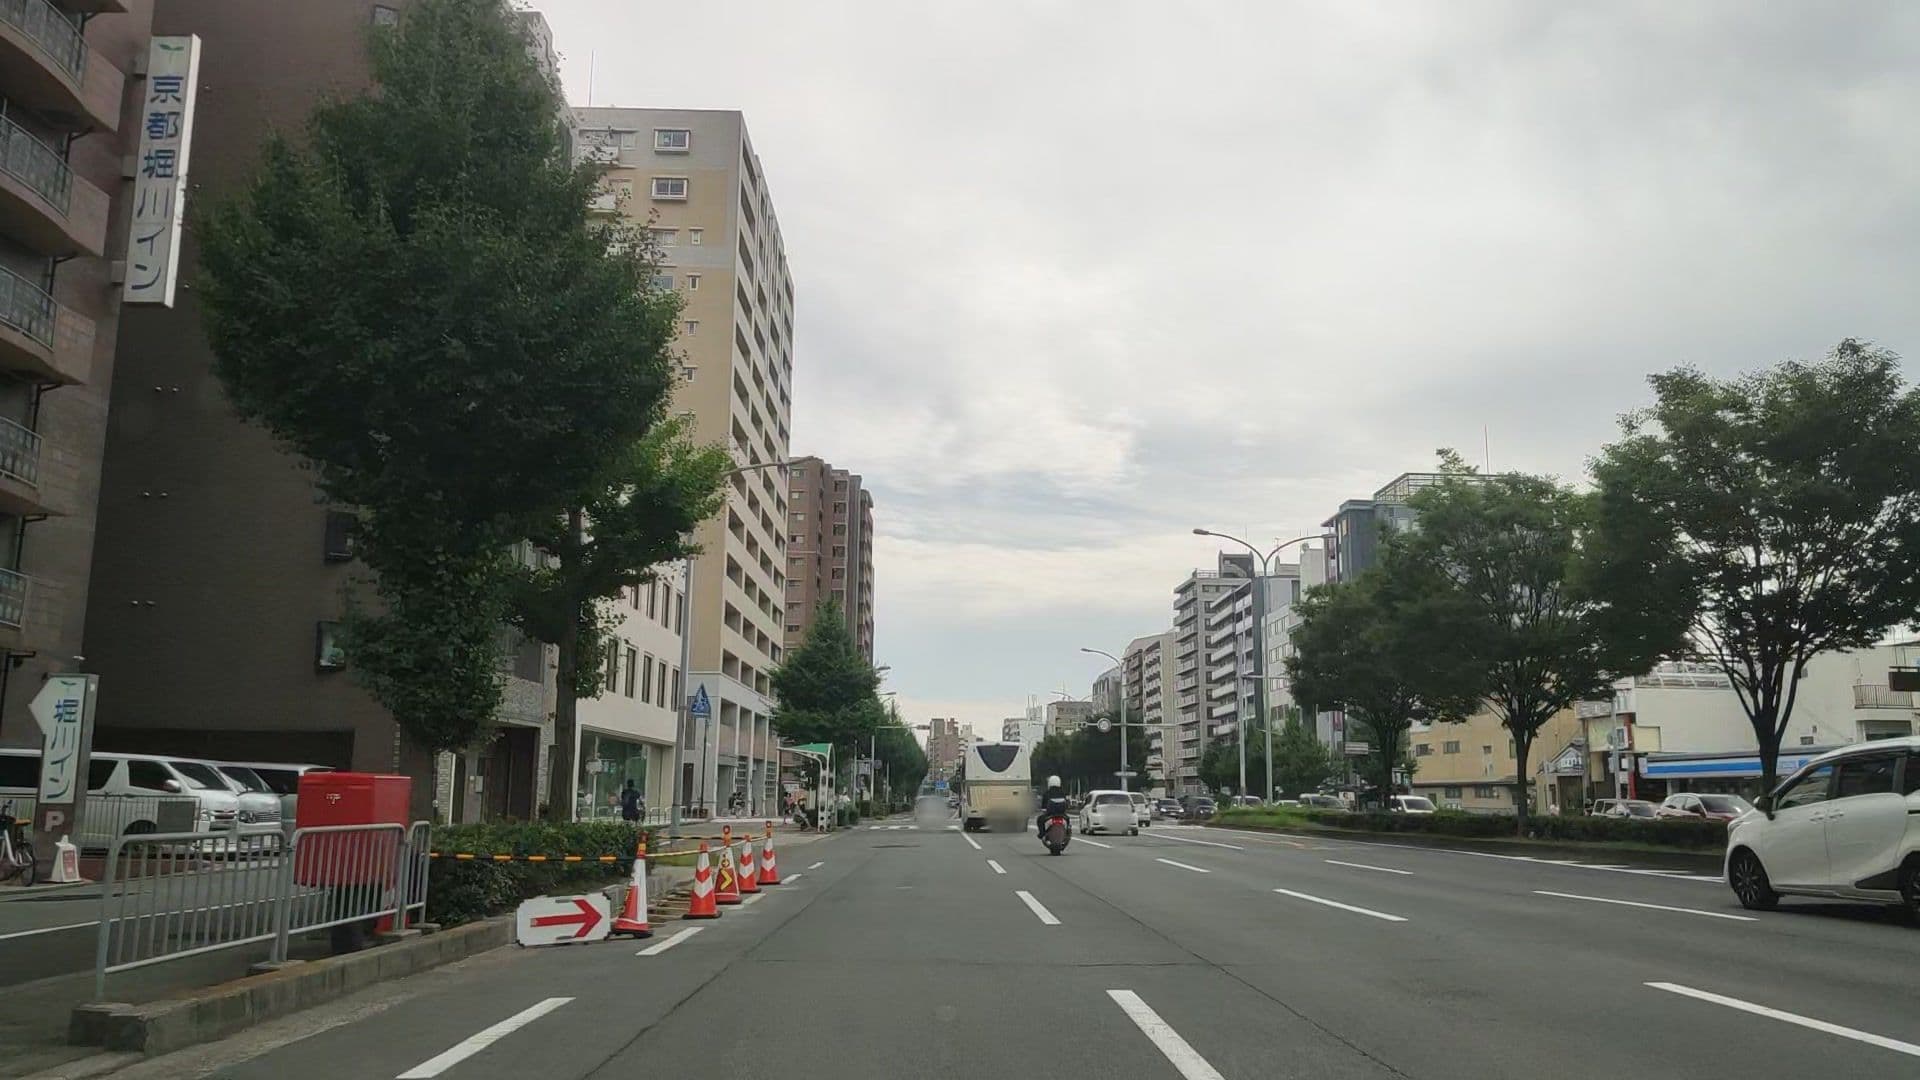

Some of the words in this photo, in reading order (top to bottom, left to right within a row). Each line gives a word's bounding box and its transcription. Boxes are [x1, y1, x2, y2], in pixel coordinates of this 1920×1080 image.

[131, 75, 184, 289] 京都堀川イン
[46, 698, 80, 799] 堀川イン
[44, 811, 65, 832] P
